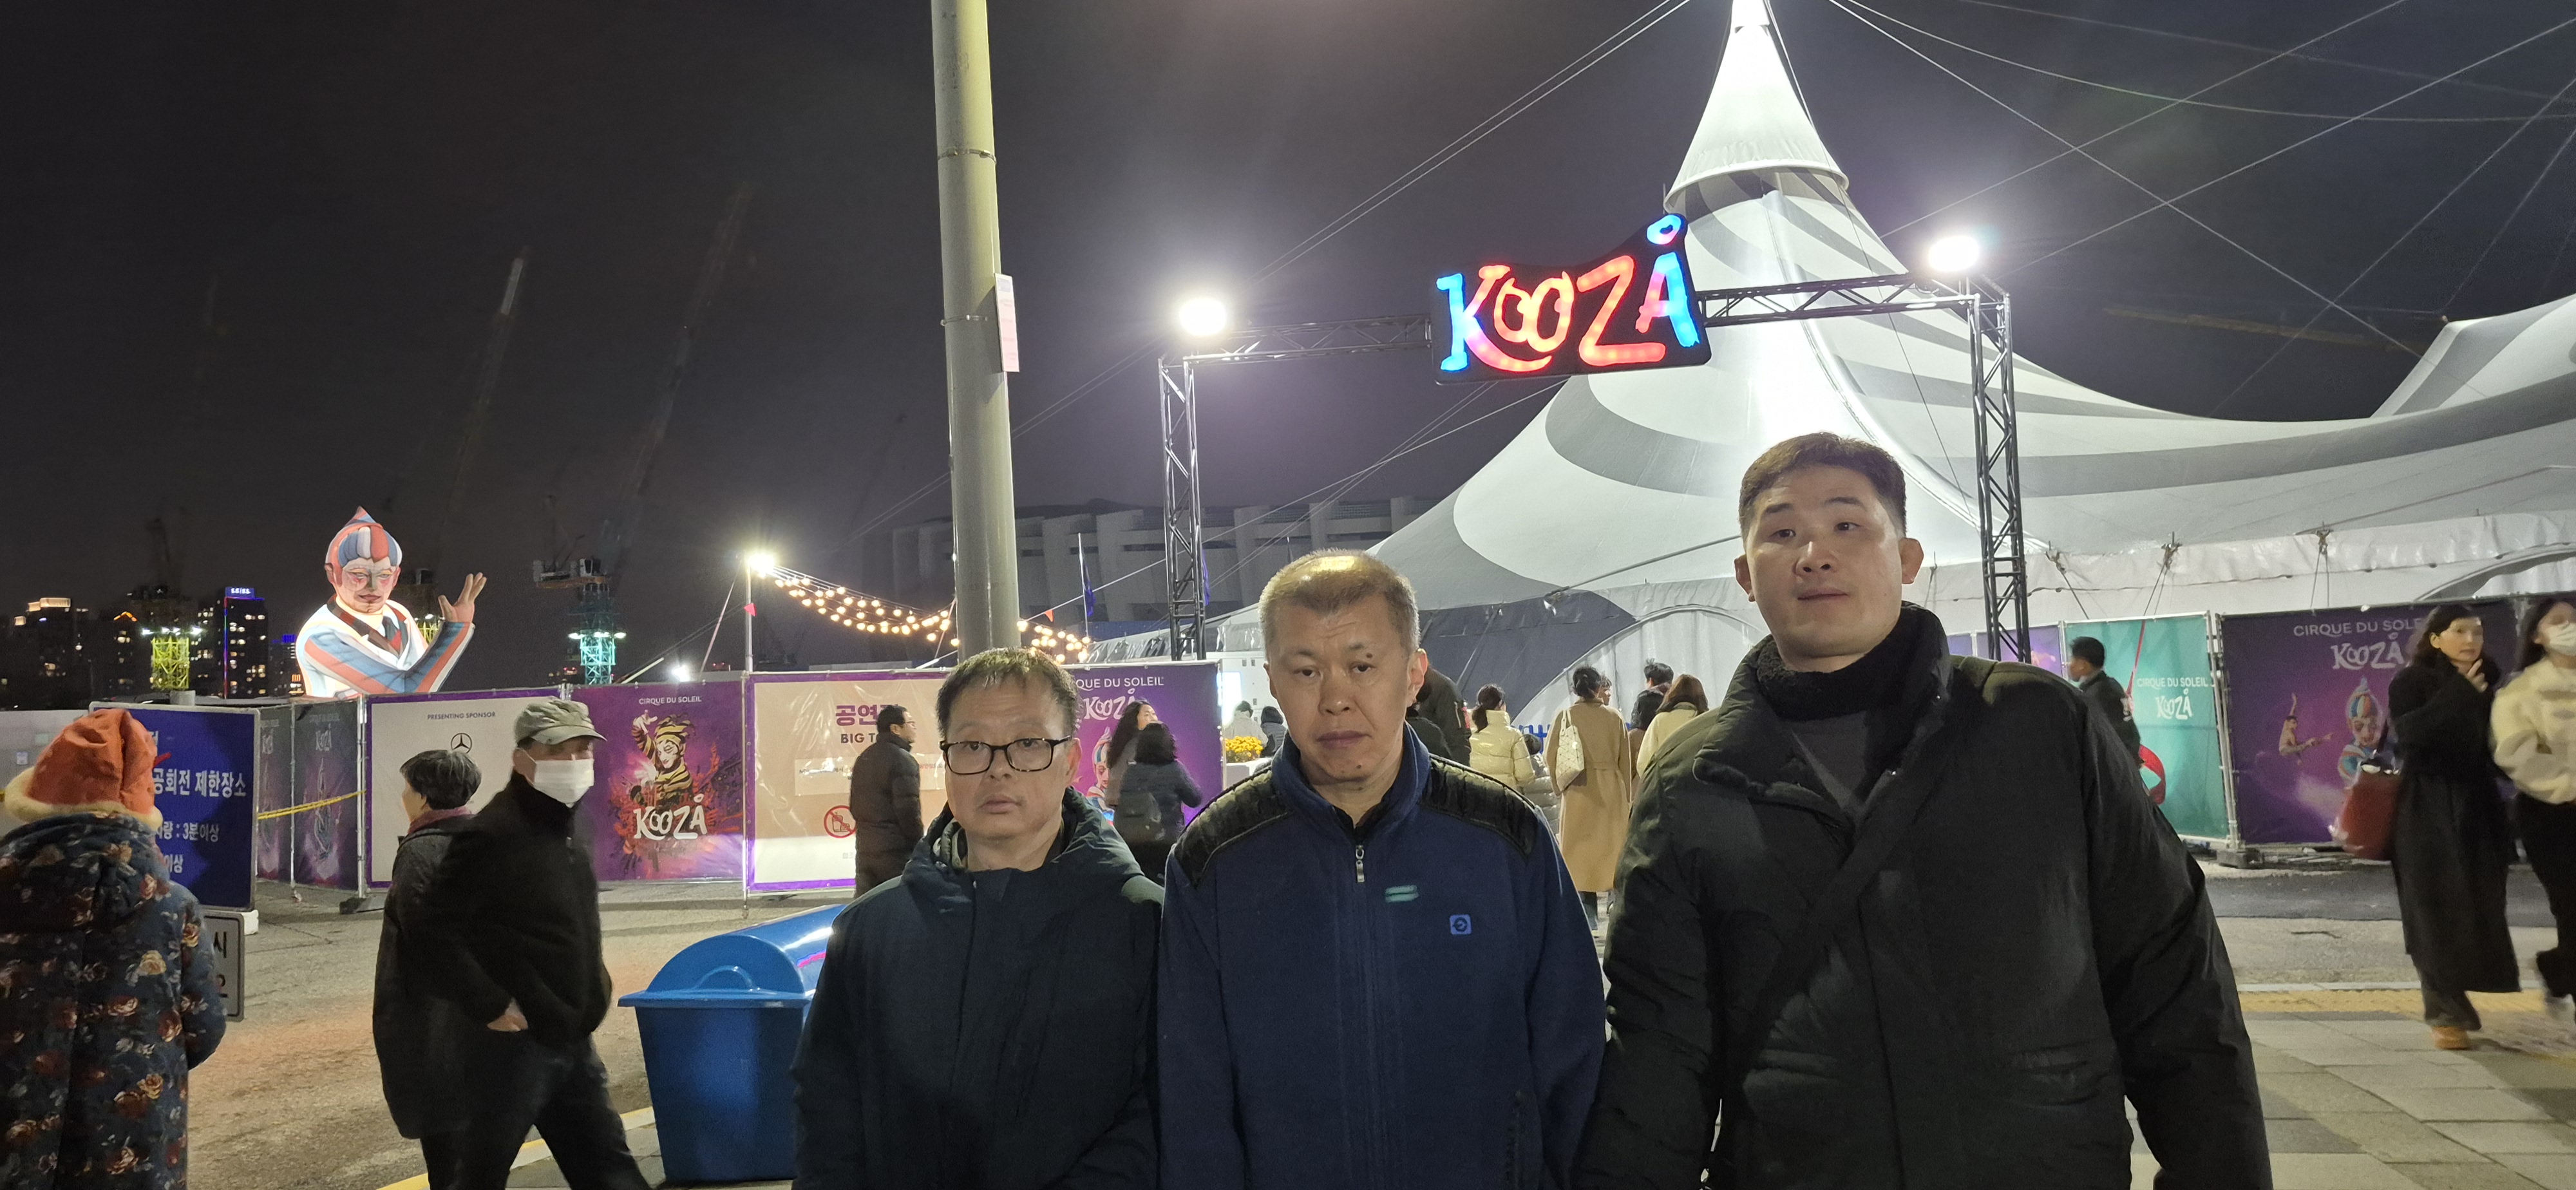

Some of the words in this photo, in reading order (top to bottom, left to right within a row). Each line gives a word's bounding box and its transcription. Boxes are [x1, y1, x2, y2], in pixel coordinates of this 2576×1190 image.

[2293, 621, 2352, 638] CIRQUE
[2356, 621, 2378, 633] DU
[1104, 678, 1121, 688] DU
[1124, 676, 1164, 686] SOLEIL
[2138, 677, 2166, 690] CIRQUE
[2167, 677, 2179, 687] DU
[2180, 677, 2209, 688] SOLEIL
[638, 697, 665, 706] CIRQUE
[840, 733, 865, 744] BIG
[194, 770, 247, 798] 제한장소
